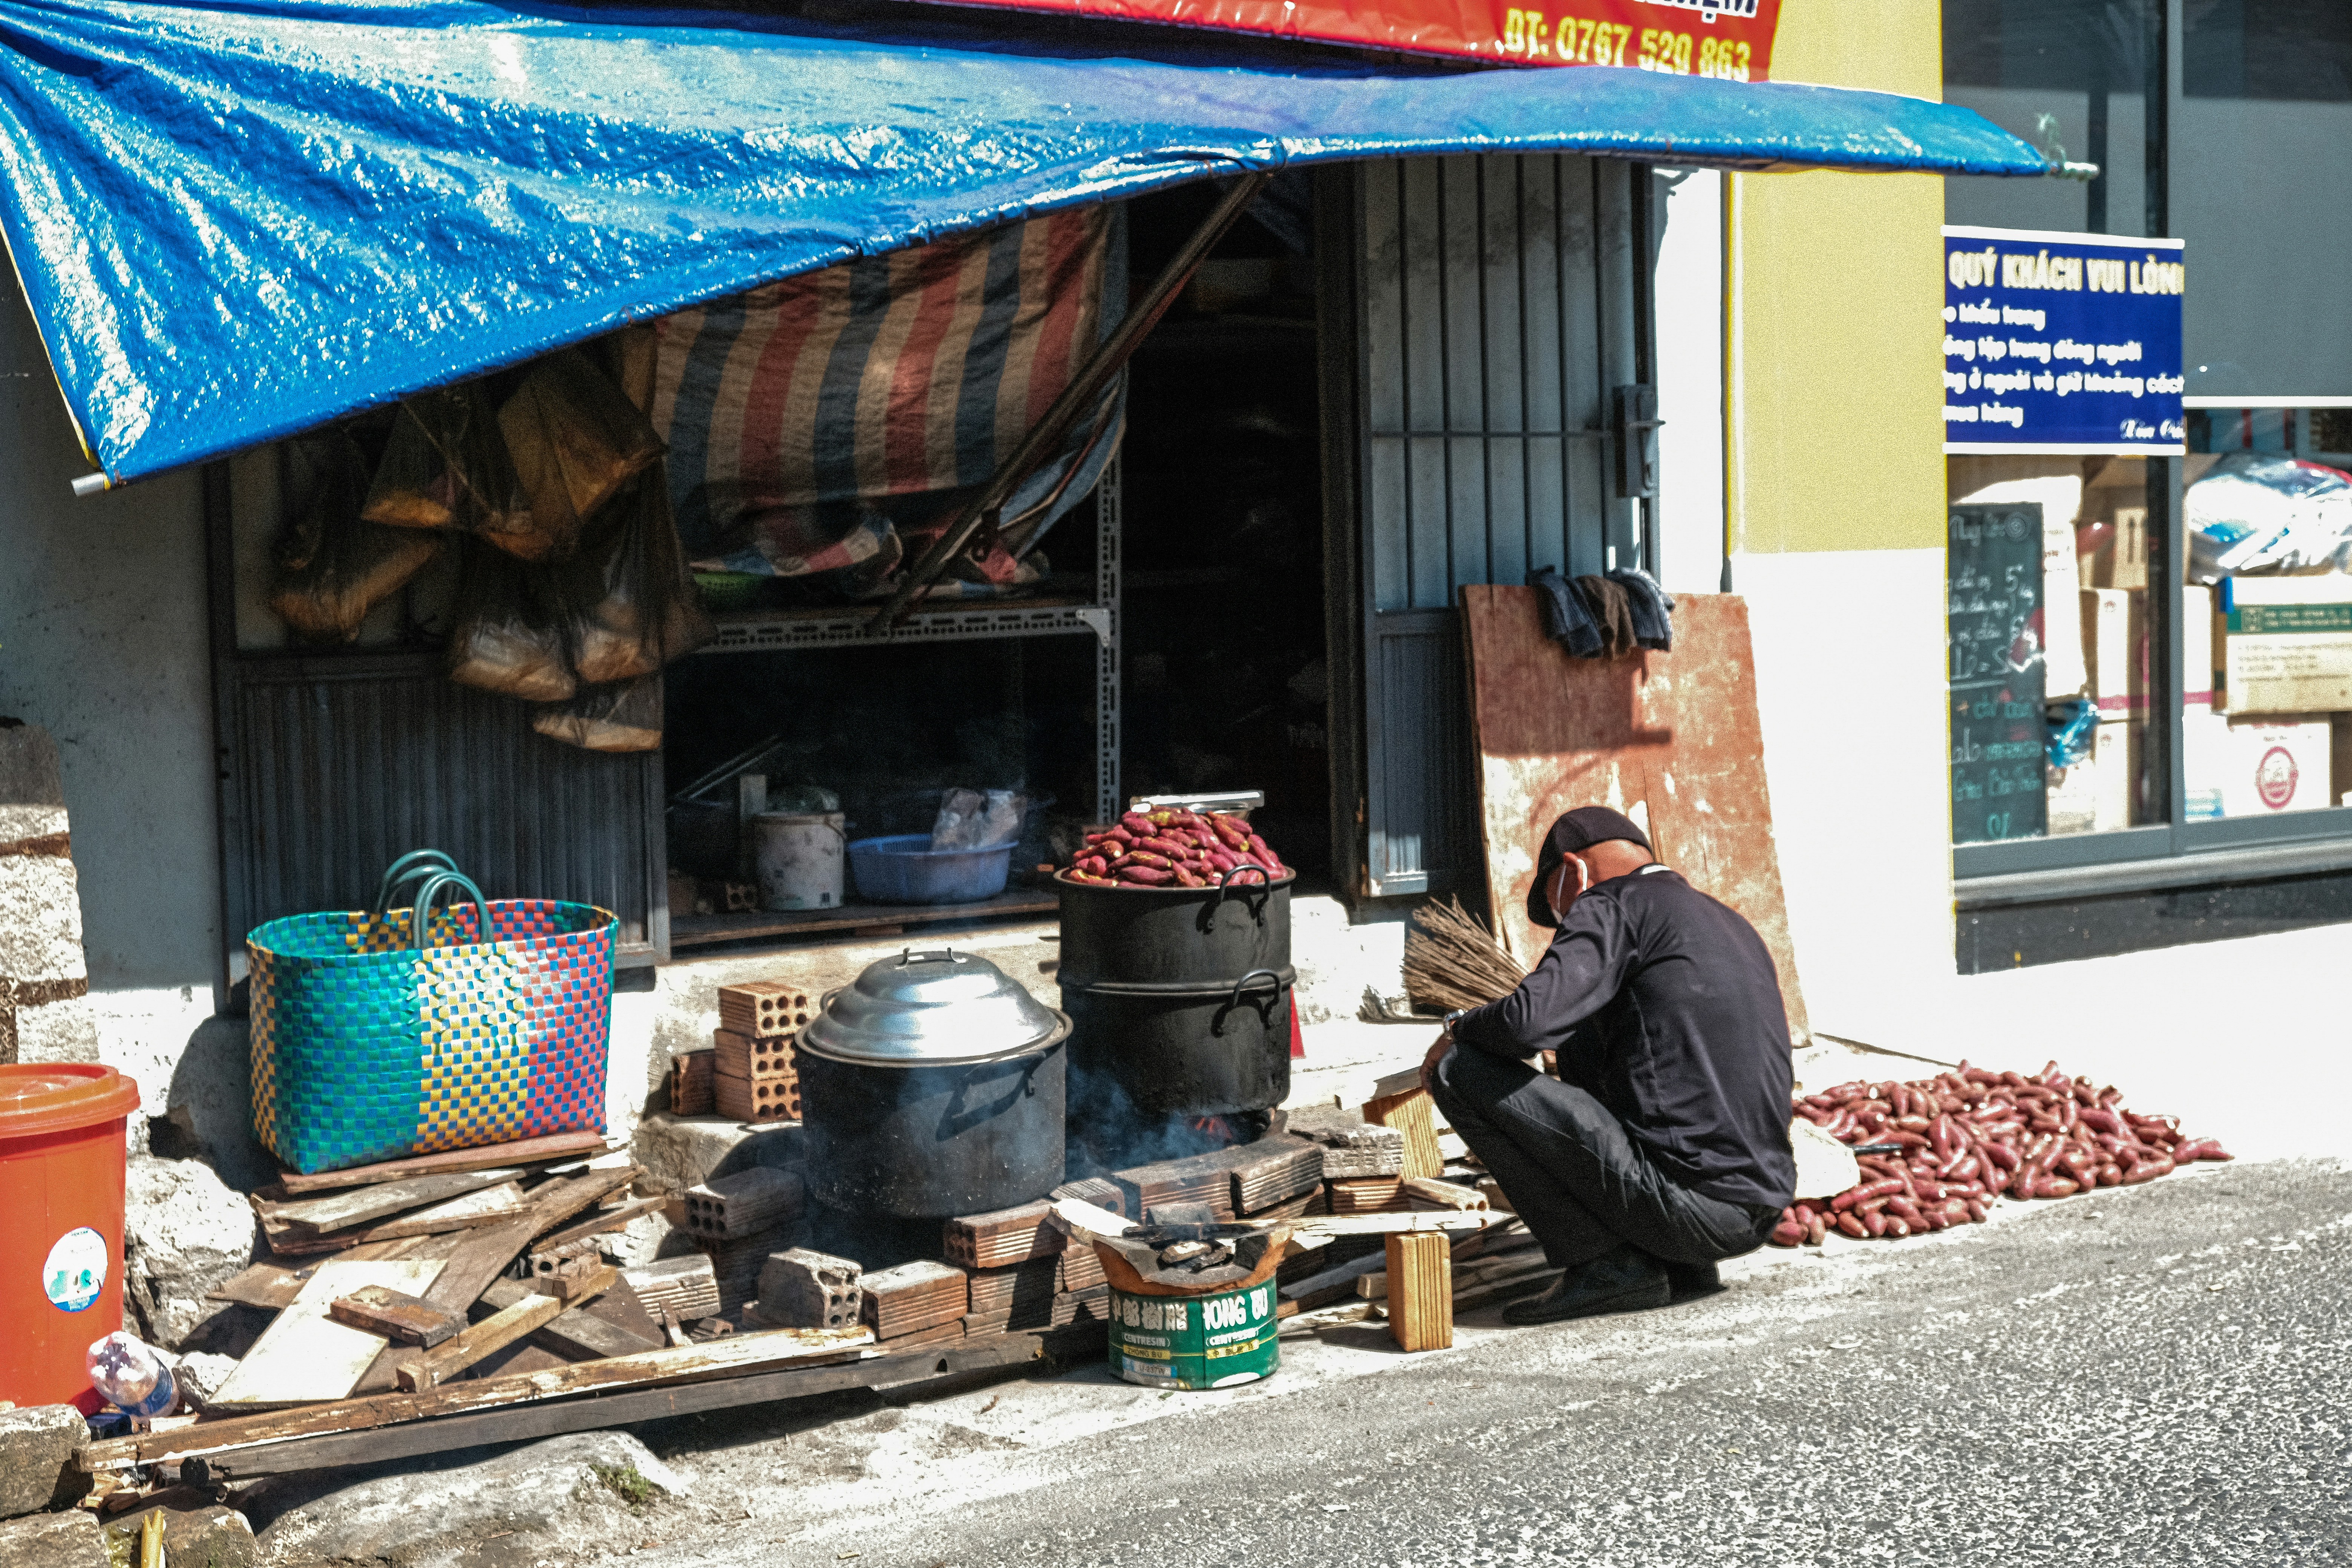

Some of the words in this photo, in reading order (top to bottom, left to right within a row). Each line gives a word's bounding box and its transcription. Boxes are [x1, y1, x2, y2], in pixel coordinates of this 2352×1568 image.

[1556, 16, 1633, 67] 0767
[1699, 36, 1750, 83] 863
[1948, 247, 1998, 289] QUÝ
[2002, 250, 2083, 291] KHÁCH
[2086, 258, 2126, 293] VUI
